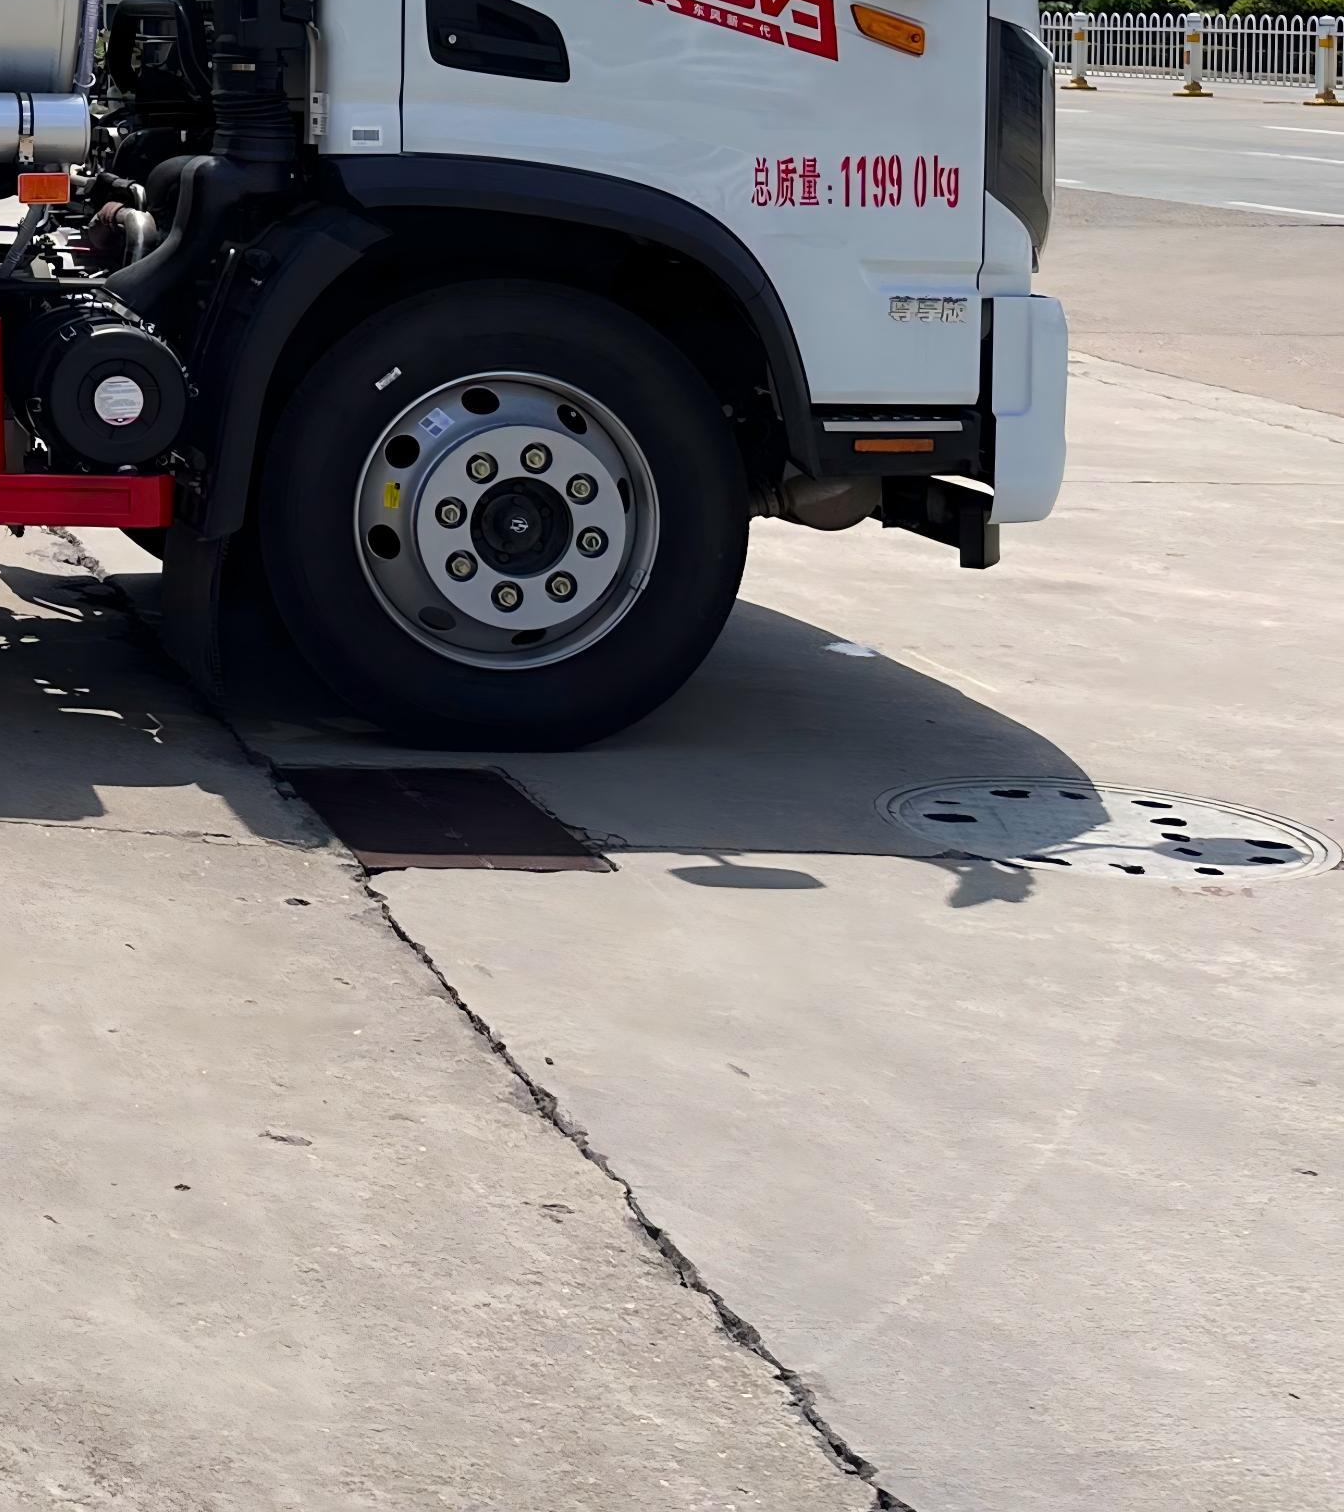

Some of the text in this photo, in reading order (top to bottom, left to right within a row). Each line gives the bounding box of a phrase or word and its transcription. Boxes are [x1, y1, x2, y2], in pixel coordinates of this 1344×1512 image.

[693, 3, 771, 38] 东风新一代
